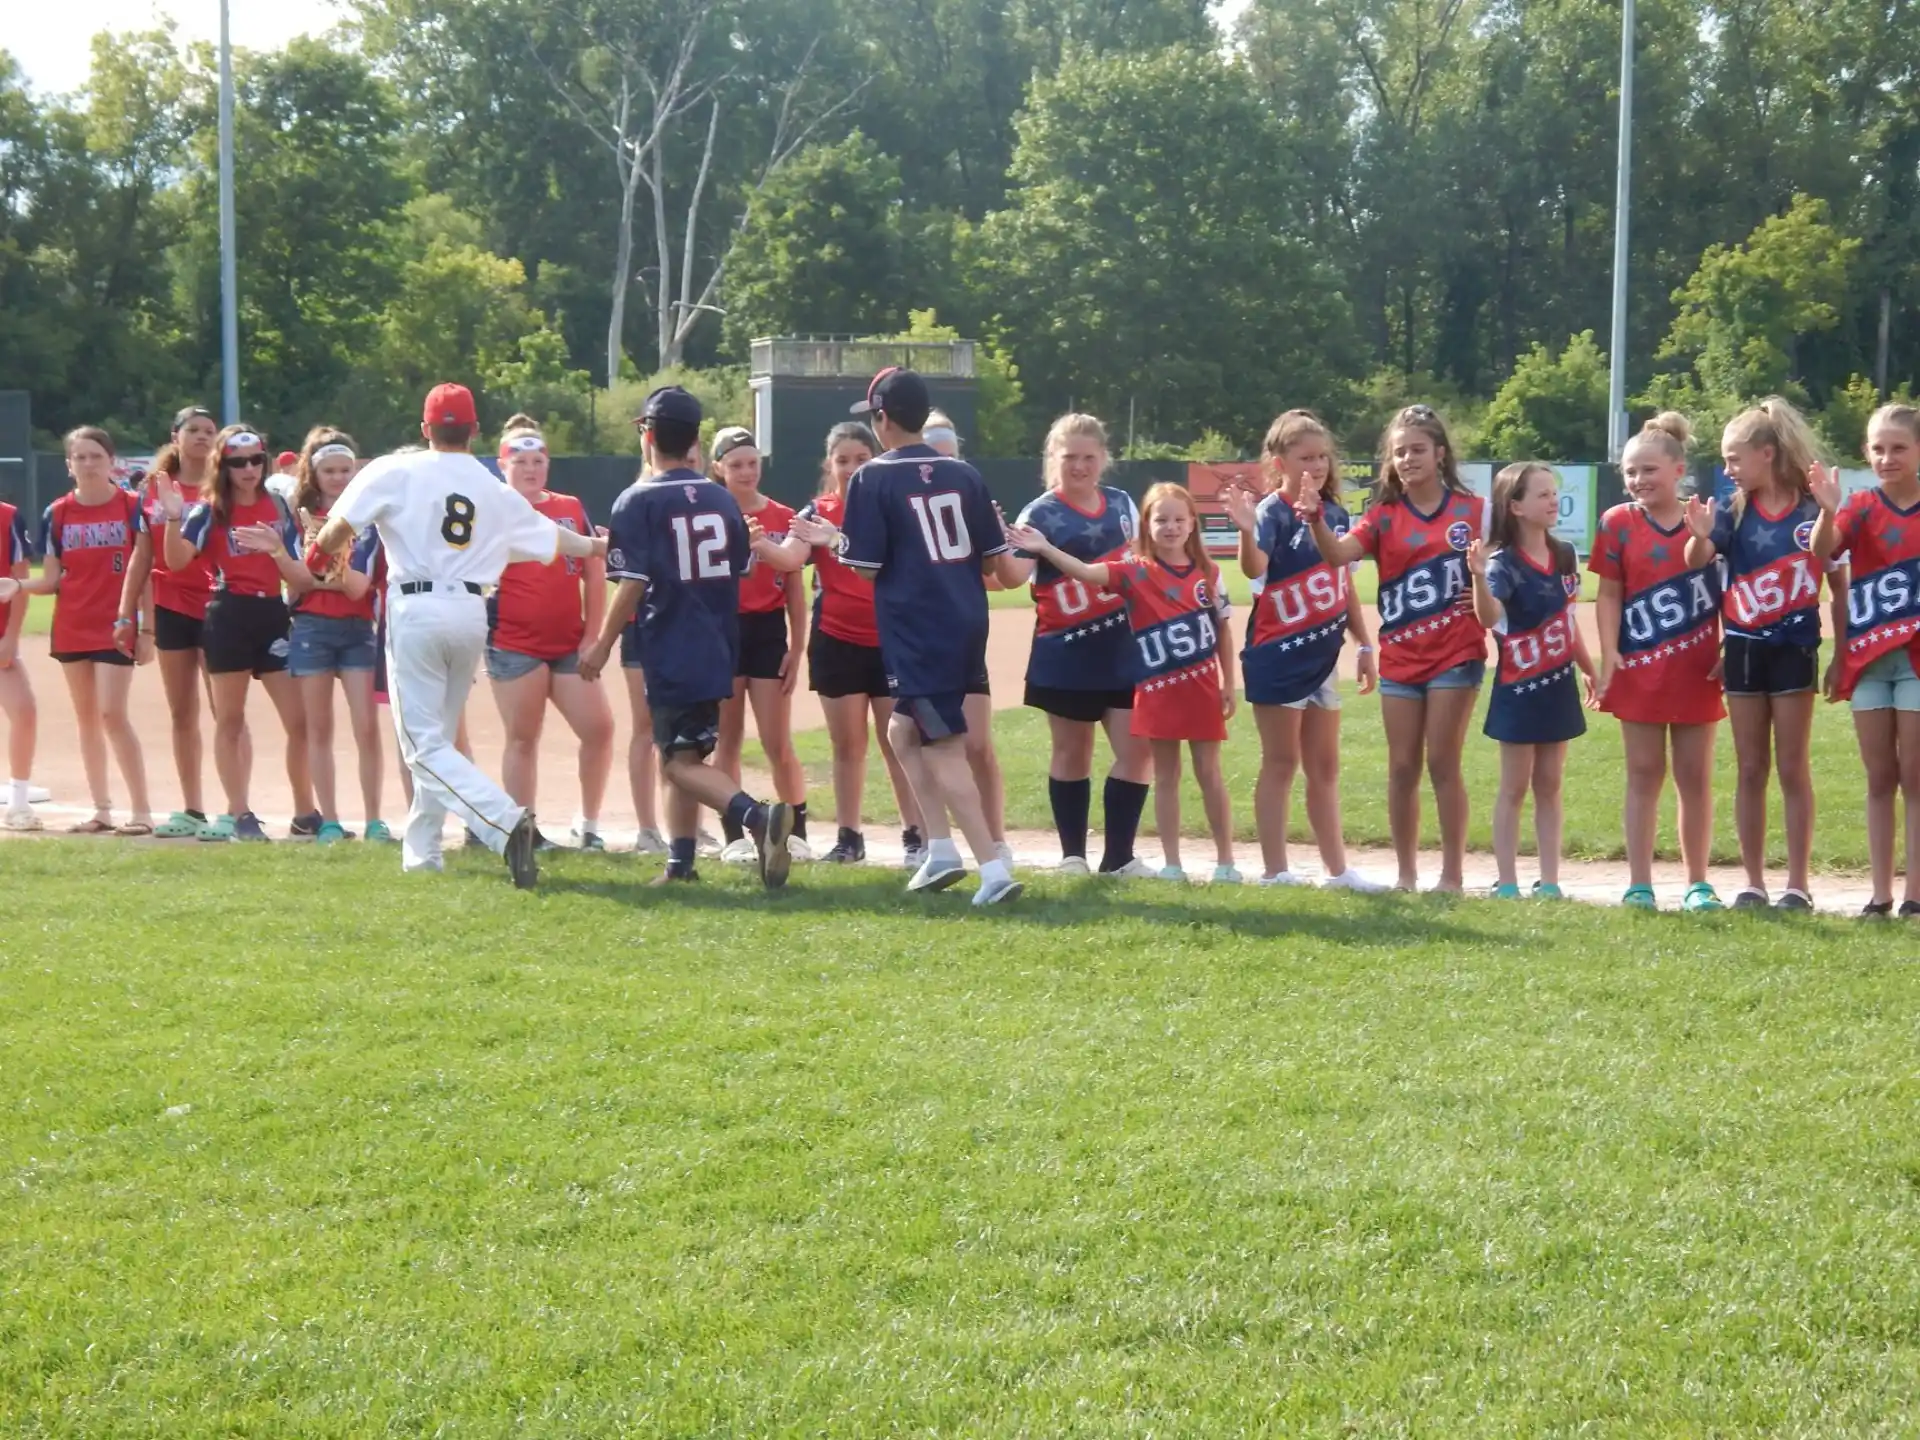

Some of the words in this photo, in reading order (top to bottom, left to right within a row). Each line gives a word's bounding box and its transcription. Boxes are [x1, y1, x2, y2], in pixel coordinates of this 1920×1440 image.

[441, 492, 475, 549] 8
[671, 513, 731, 581] 12
[909, 492, 972, 561] 10
[1381, 558, 1465, 622] USA
[1625, 574, 1713, 640] USA
[1732, 559, 1817, 623] USA
[1847, 561, 1920, 625] US
[1136, 612, 1217, 668] USA
